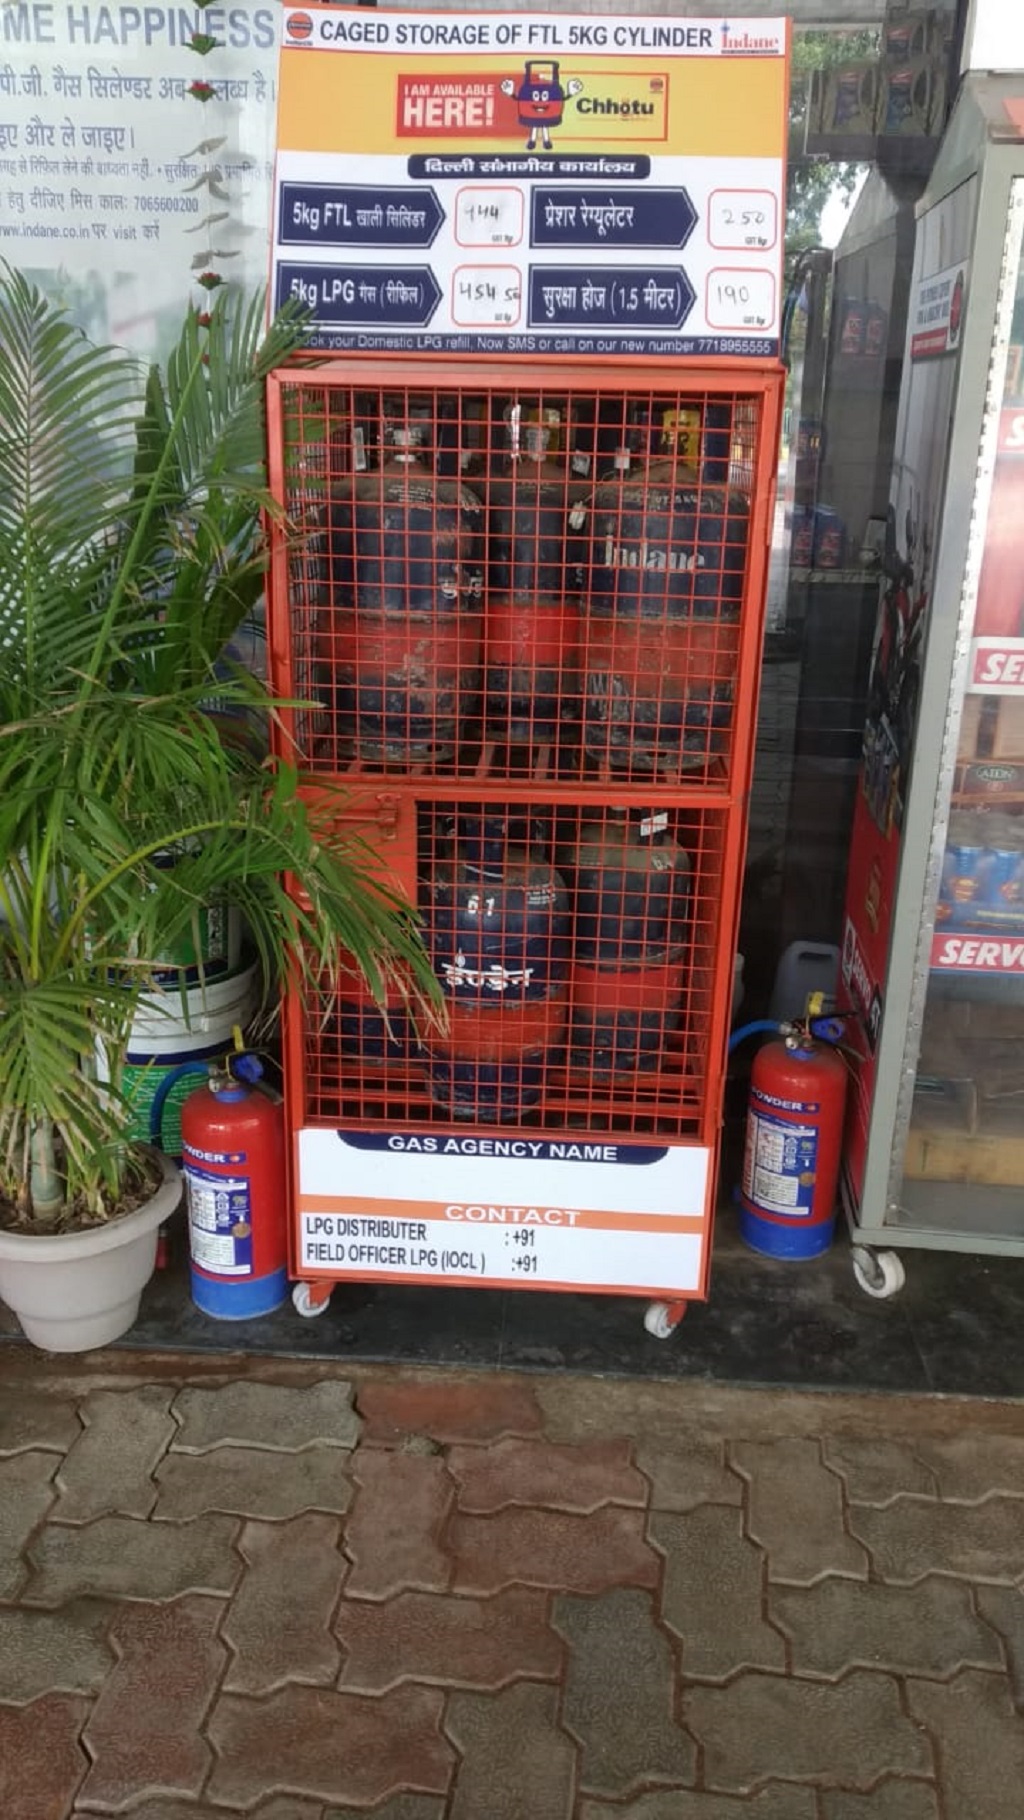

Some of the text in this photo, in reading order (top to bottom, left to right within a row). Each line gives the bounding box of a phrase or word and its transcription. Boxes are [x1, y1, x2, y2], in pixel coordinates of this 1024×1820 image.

[2, 2, 275, 48] ME HAPPINESS
[320, 20, 713, 48] CAGED STORAGE OF FTL 5KG CYLINDER
[53, 64, 82, 98] गैस
[404, 84, 494, 96] I AM AVAILABLE
[403, 97, 495, 127] HERE!
[576, 97, 654, 115] Chhotu
[25, 114, 55, 148] और
[424, 157, 475, 173] दिल्ली
[559, 157, 636, 174] कार्यालय
[134, 194, 199, 213] 7065600200
[545, 198, 577, 229] प्रेशर
[293, 202, 320, 231] 5kg
[324, 203, 353, 227] FTL
[112, 224, 137, 240] visit
[290, 278, 318, 308] 5kg
[322, 279, 355, 304] LPG
[717, 285, 749, 305] 190
[328, 336, 355, 349] your
[357, 335, 413, 349] Domestic
[416, 337, 442, 349] LPG
[477, 337, 503, 350] Now
[507, 337, 535, 350] SMS
[538, 339, 551, 350] or
[554, 338, 576, 351] call
[578, 340, 594, 351] on
[596, 340, 616, 352] our
[620, 340, 645, 352] new
[649, 340, 695, 353] number
[980, 653, 1024, 682] SE
[939, 939, 1024, 967] SERV
[387, 1136, 618, 1161] GAS AGENCY NAME
[445, 1205, 581, 1225] CONTACT
[306, 1217, 334, 1235] LPG
[337, 1218, 428, 1241] DISTRIBUTER
[306, 1243, 345, 1262] FIELD
[348, 1245, 406, 1265] OFFICER
[410, 1249, 439, 1267] LPG
